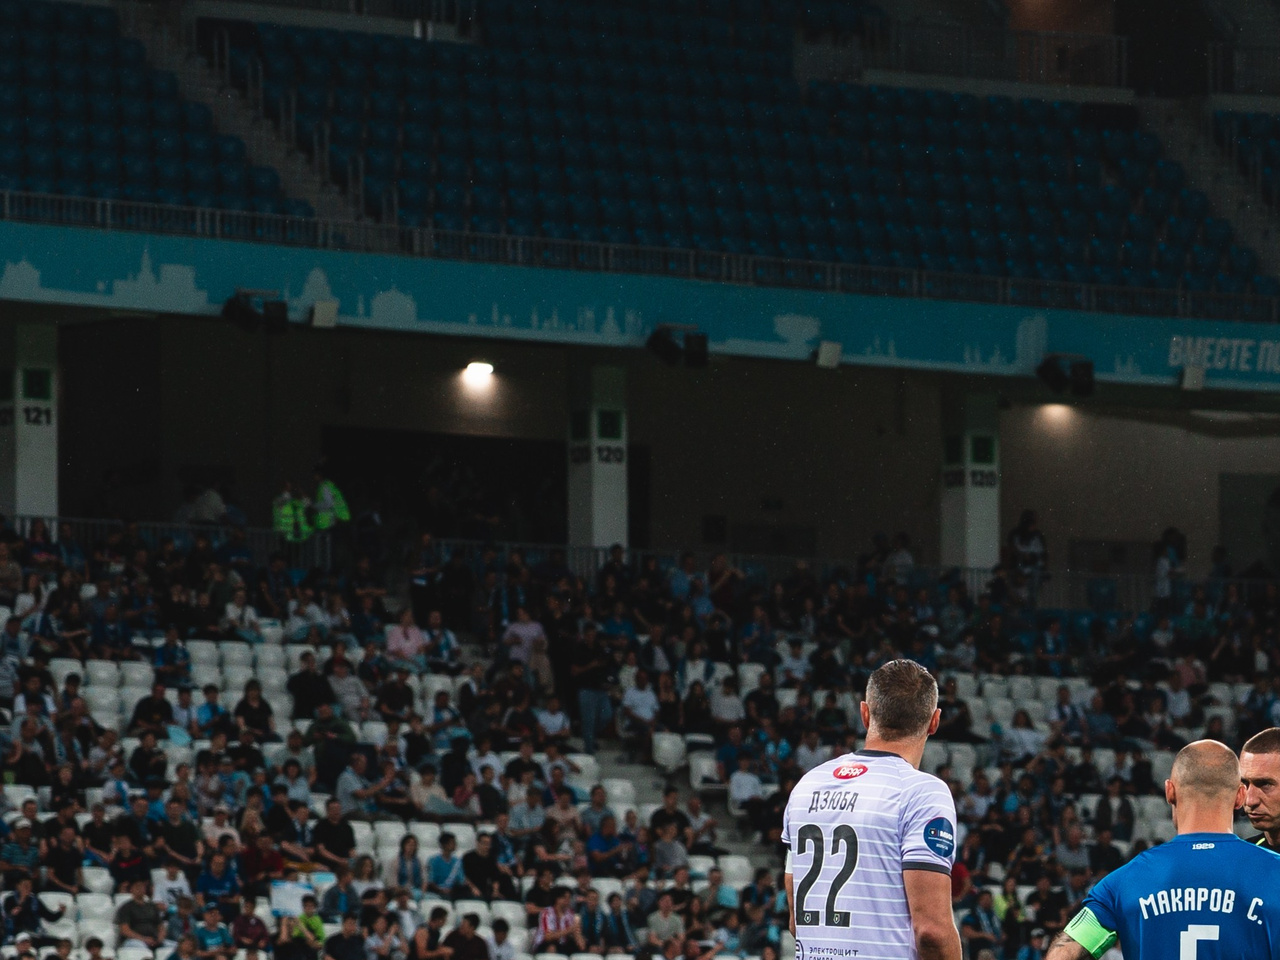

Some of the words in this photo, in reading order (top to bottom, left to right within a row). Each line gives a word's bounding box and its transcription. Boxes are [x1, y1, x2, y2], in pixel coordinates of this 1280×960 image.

[1168, 335, 1255, 371] ВМЕСТЕ
[24, 407, 51, 424] 121
[596, 446, 625, 463] 120
[970, 471, 997, 486] 120
[808, 790, 859, 813] ДЗЮБА
[795, 823, 858, 927] 22
[1139, 888, 1236, 920] МАКАРОВ
[1246, 897, 1264, 925] С.
[809, 946, 859, 957] ЭЛЕКТРОЩИТ
